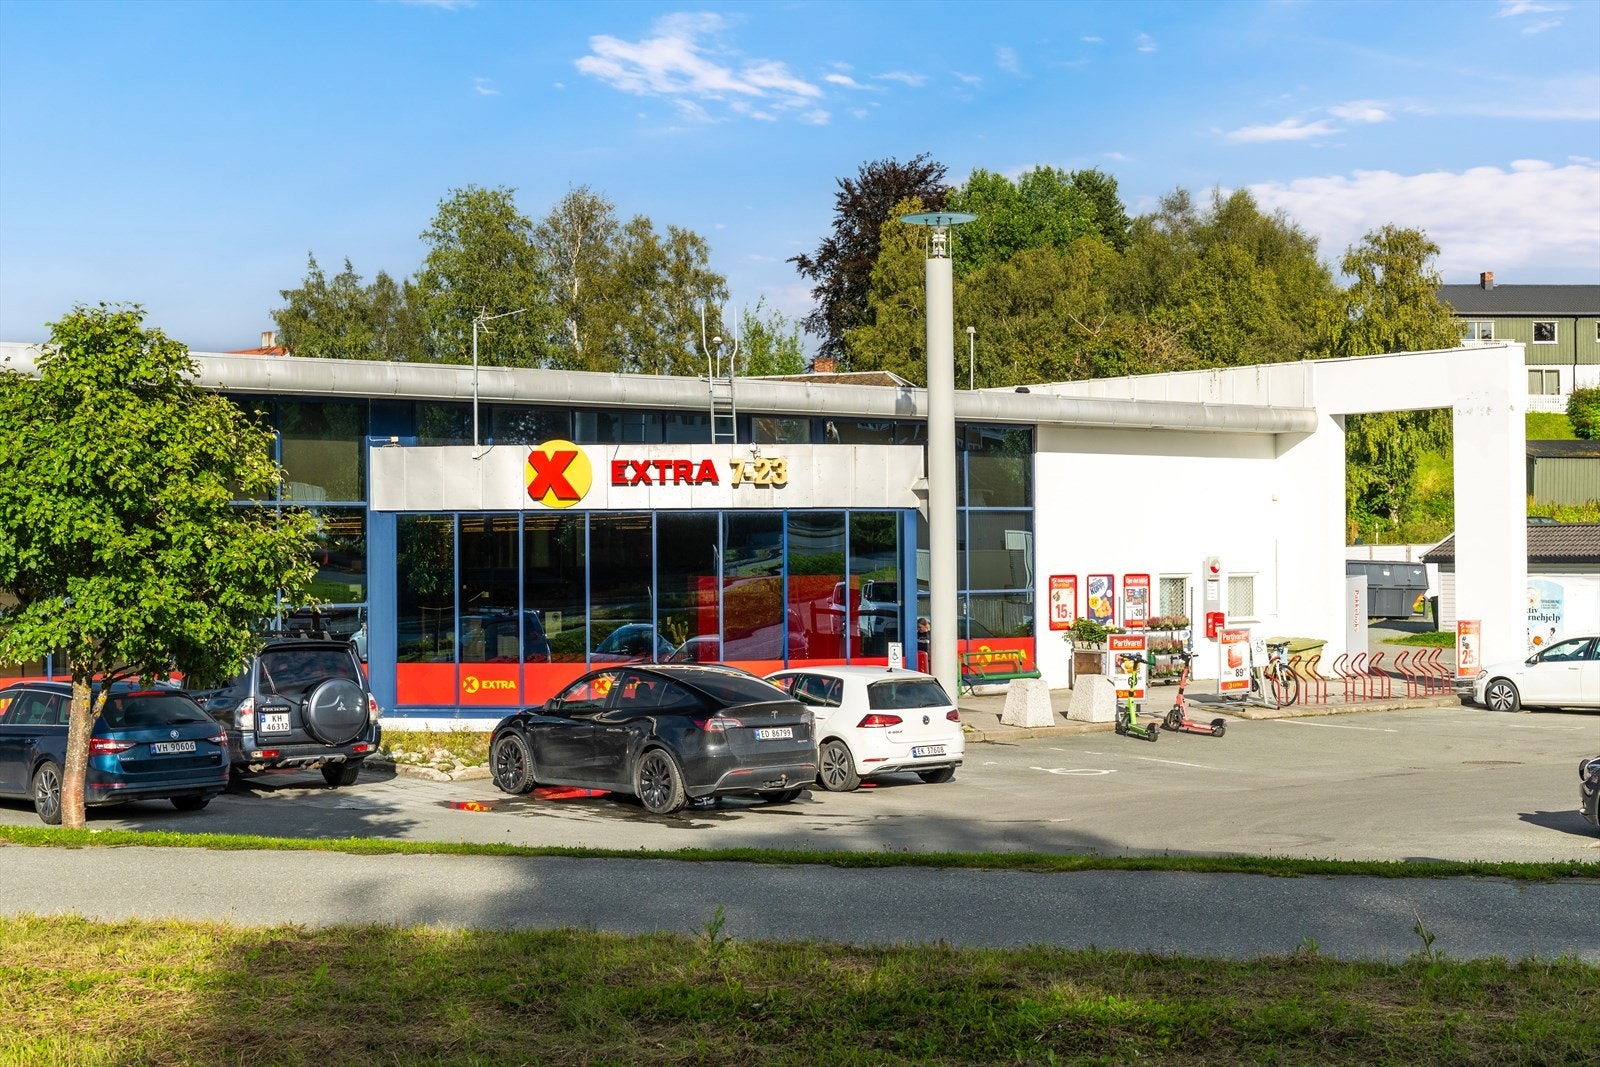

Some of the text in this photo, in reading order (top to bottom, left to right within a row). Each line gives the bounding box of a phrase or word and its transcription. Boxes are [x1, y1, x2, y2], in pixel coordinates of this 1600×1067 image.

[611, 457, 788, 488] EXTRA 7-23
[1527, 606, 1539, 614] tiv
[1527, 613, 1561, 623] rnehjelp
[1113, 638, 1143, 648] Partivare!
[481, 680, 516, 689] EXTRA
[760, 729, 791, 739] ED 86799
[157, 743, 195, 752] VH 90606
[917, 746, 944, 755] EK 37608
